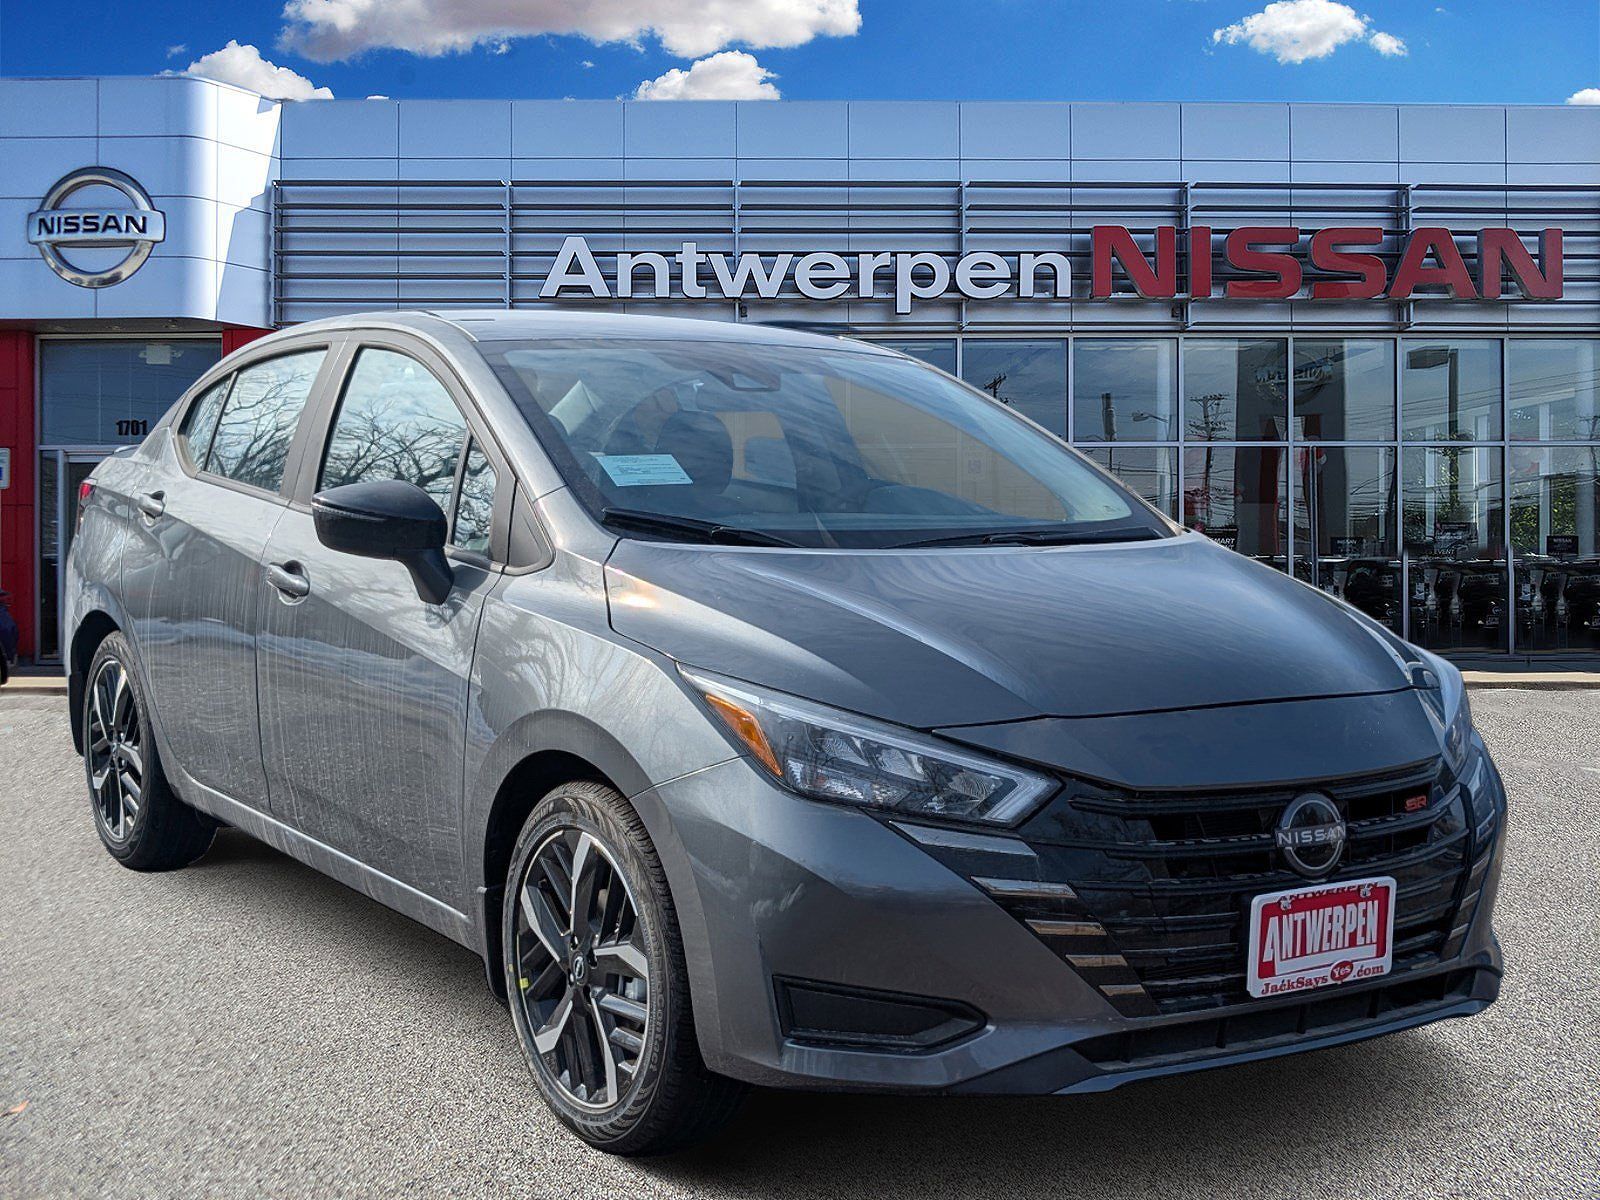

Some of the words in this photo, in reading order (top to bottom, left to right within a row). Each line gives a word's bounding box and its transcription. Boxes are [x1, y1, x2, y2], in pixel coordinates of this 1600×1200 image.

[38, 215, 147, 235] NISSAN
[539, 235, 1071, 313] Antwerpen
[1091, 225, 1564, 300] NISSAN
[115, 420, 147, 436] 1701
[1405, 795, 1427, 811] SR
[1278, 826, 1346, 845] NISSAN
[1262, 900, 1379, 966] ANTWERPEN
